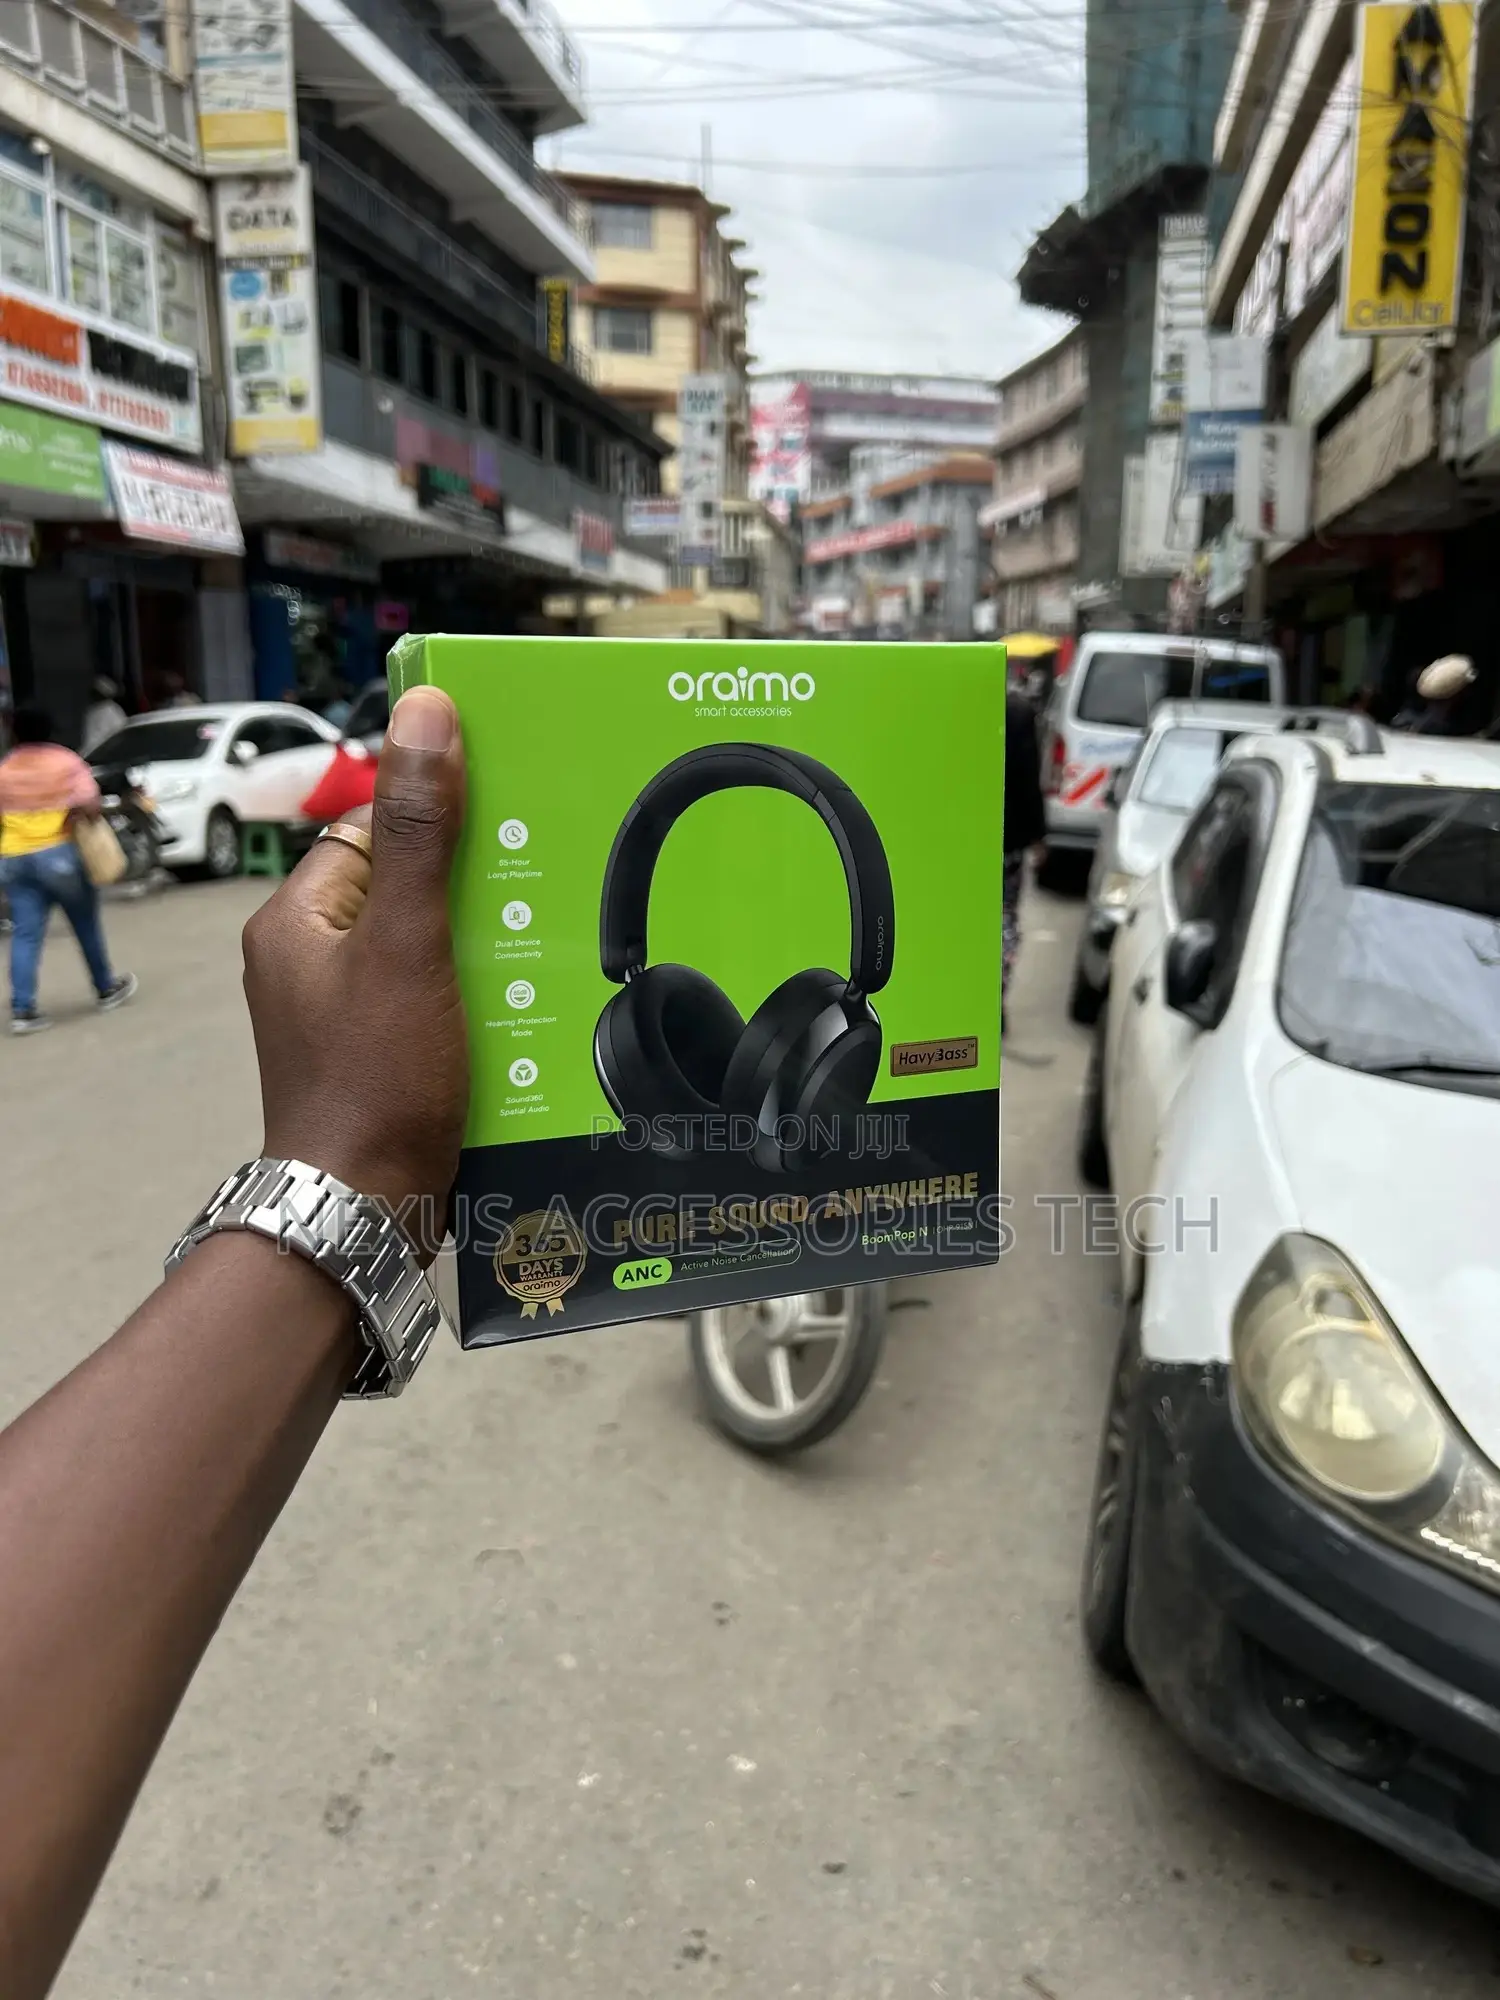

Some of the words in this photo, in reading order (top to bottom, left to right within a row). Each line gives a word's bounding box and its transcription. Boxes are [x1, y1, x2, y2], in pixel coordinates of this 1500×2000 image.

[1379, 4, 1444, 297] AMAZON
[668, 666, 815, 701] oraimo
[694, 705, 727, 717] smart
[730, 705, 792, 717] accessories
[487, 871, 508, 880] Long
[509, 870, 543, 880] Playtime
[495, 940, 513, 948] Dual
[515, 939, 541, 947] Device
[875, 915, 885, 971] oraimo
[495, 951, 543, 960] Connectivity
[485, 1019, 516, 1028] Hearing
[517, 1016, 557, 1025] Protection
[511, 1029, 533, 1037] Mode
[505, 1094, 544, 1104] Sound360
[500, 1107, 526, 1117] Spatial
[527, 1105, 550, 1114] Audio
[613, 1210, 696, 1249] PURE
[824, 1172, 979, 1219] ANYWHERE
[861, 1229, 916, 1246] BoomPop
[919, 1227, 928, 1237] N
[515, 1230, 566, 1257] 365
[680, 1259, 709, 1271] Active
[711, 1256, 737, 1267] Noise
[740, 1248, 795, 1262] Cancellation
[519, 1257, 564, 1277] DAYS
[519, 1270, 564, 1282] WARRANTY
[621, 1264, 663, 1284] ANC
[523, 1279, 561, 1292] oraimo
